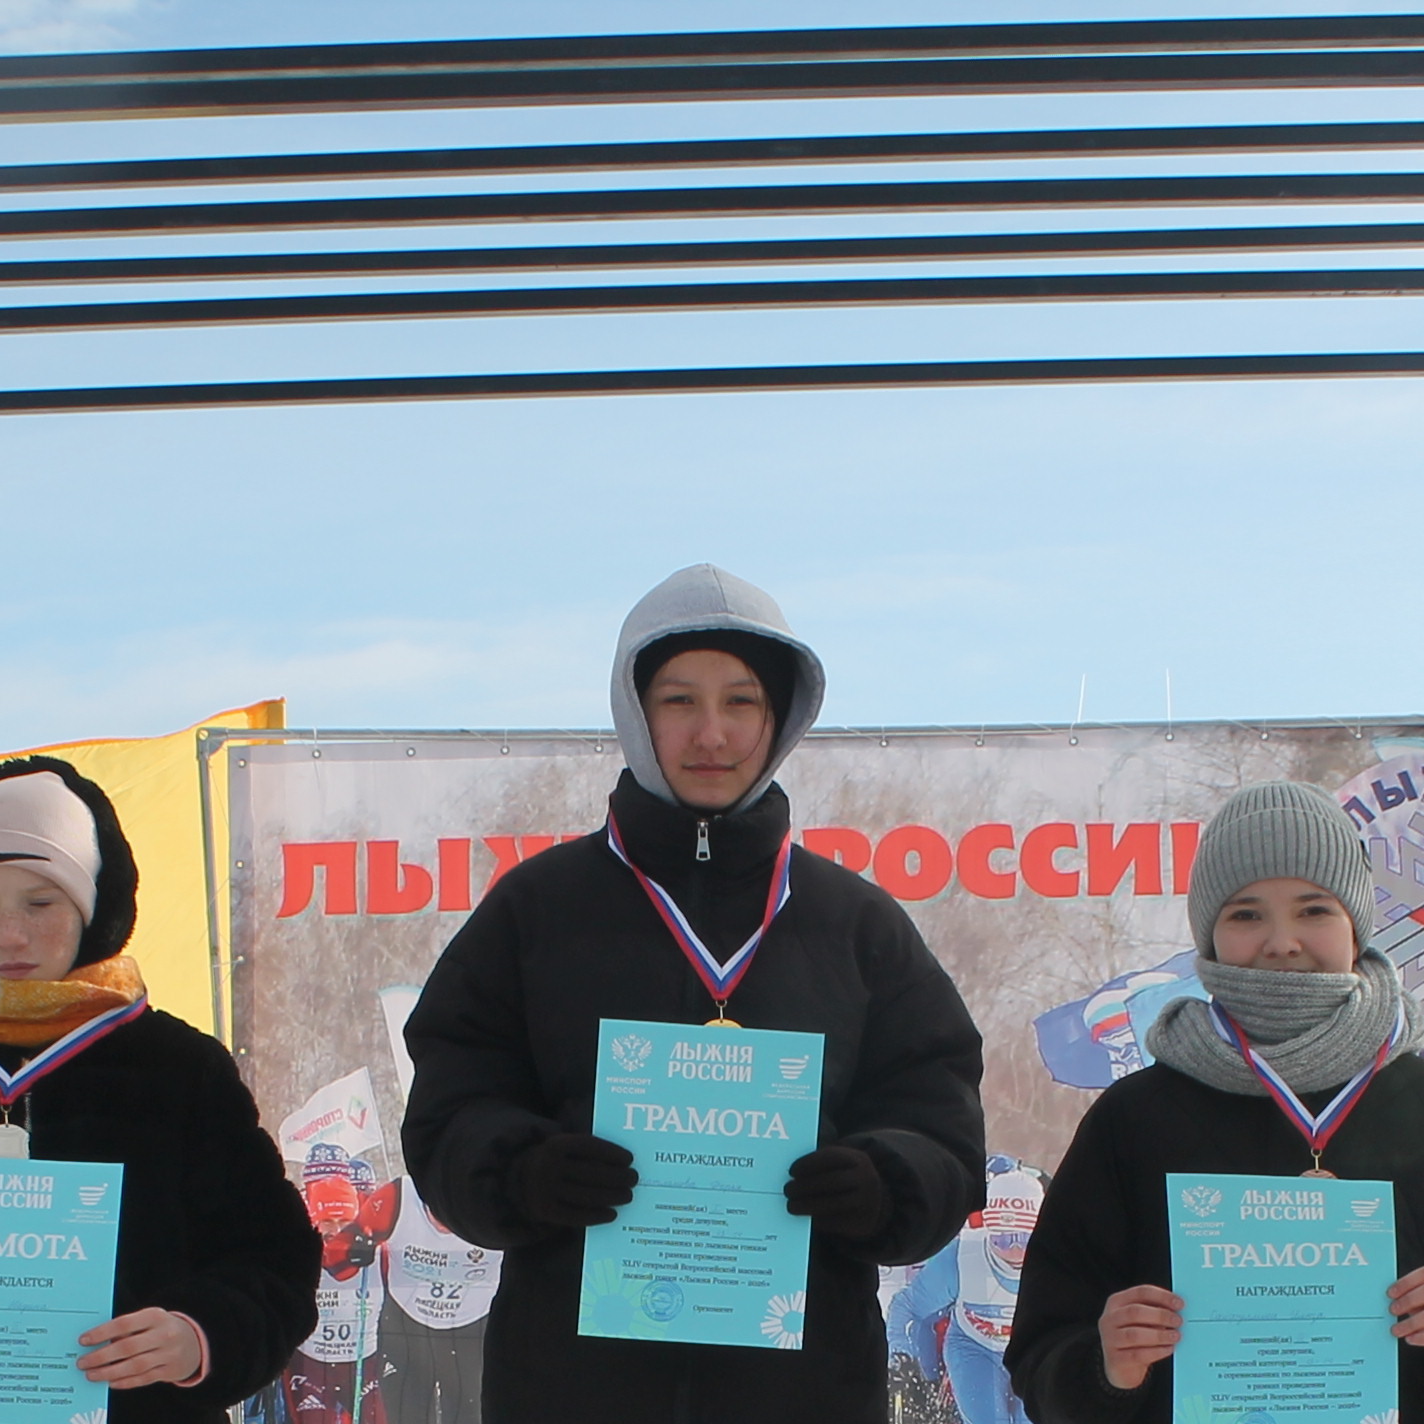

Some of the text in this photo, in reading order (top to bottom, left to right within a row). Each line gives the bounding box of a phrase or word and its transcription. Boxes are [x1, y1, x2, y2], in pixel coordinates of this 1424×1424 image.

[670, 1042, 753, 1064] ЛЫЖНЯ
[668, 1061, 752, 1083] РОССИИ
[623, 1103, 789, 1140] ГРАМОТА
[655, 1152, 754, 1168] НАГРАЖДАЕТСЯ
[986, 1198, 1037, 1212] UKOIL
[1240, 1190, 1324, 1206] ЛЫЖНЯ
[1240, 1206, 1325, 1221] РОССИИ
[403, 1251, 447, 1268] РОССИИ
[405, 1244, 448, 1259] ЛЫЖНЯ
[1201, 1243, 1369, 1268] ГРАМОТА
[403, 1261, 442, 1276] 2021
[431, 1281, 462, 1299] 82
[1236, 1285, 1335, 1297] НАГРАЖДАЕТСЯ
[323, 1324, 351, 1341] 50
